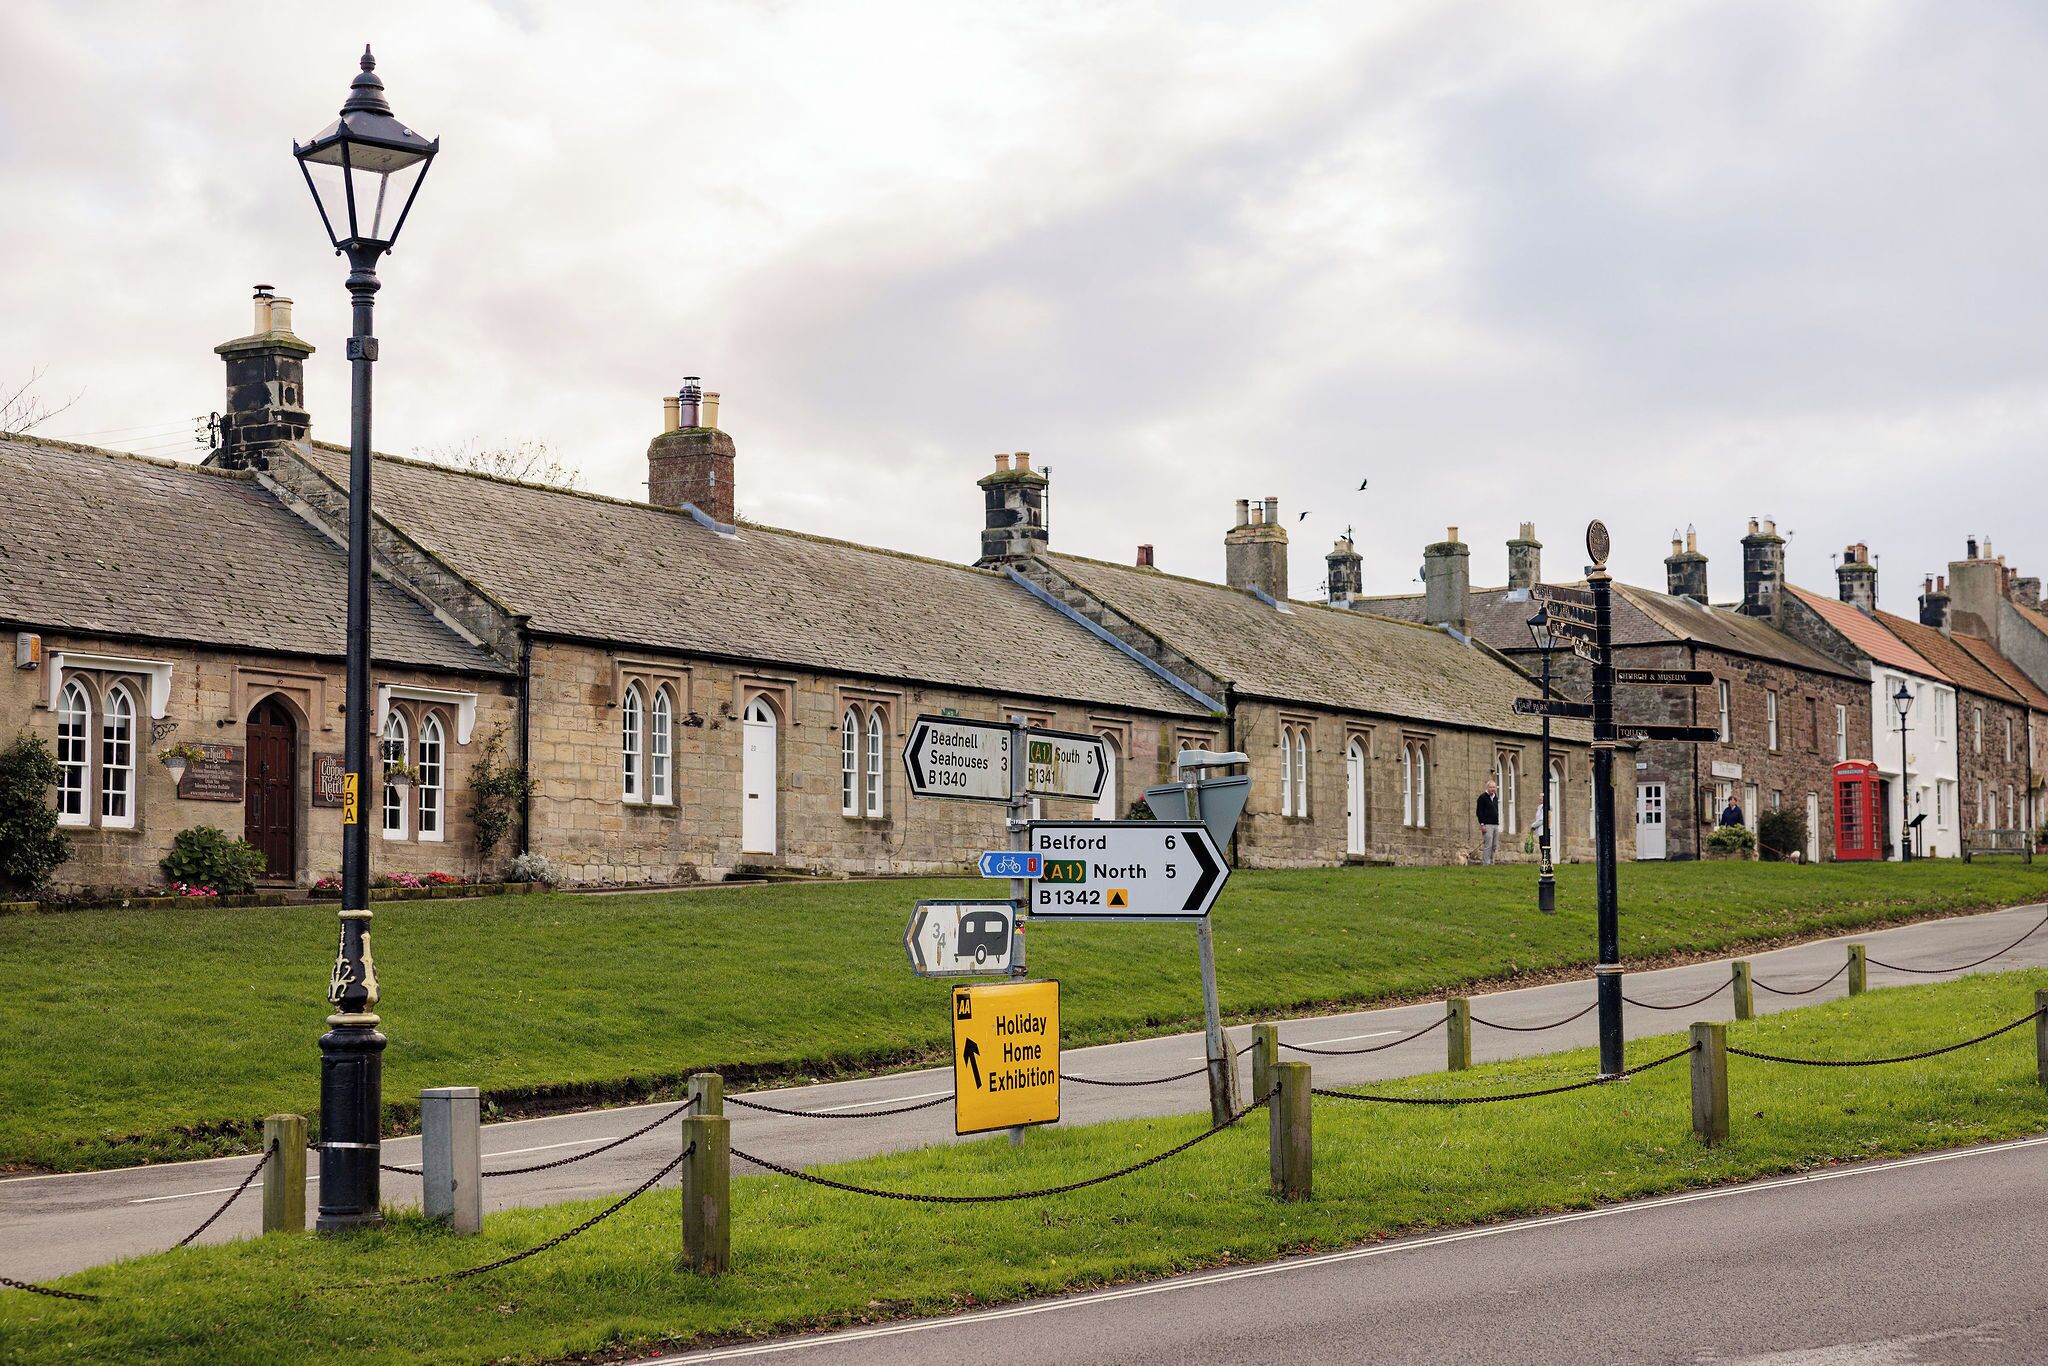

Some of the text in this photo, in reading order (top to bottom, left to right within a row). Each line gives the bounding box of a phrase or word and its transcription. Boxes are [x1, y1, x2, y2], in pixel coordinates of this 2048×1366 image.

[1618, 672, 1687, 682] CHURCH & MUSEUM
[1532, 701, 1549, 712] PARK
[931, 729, 1008, 752] Beadnell 5
[1620, 728, 1648, 738] TOILETS
[326, 755, 337, 767] The
[930, 750, 1008, 772] Seahouses 3
[1030, 742, 1093, 765] (A1) South 5
[928, 770, 967, 788] B1340
[1028, 768, 1055, 785] B1341
[1039, 834, 1176, 851] Belford 6
[1042, 862, 1177, 882] (A1) North 5
[1039, 890, 1101, 905] B1342
[958, 999, 971, 1015] AA
[996, 1013, 1048, 1036] Holiday
[1003, 1043, 1042, 1063] Home
[989, 1068, 1056, 1093] Exhibition
